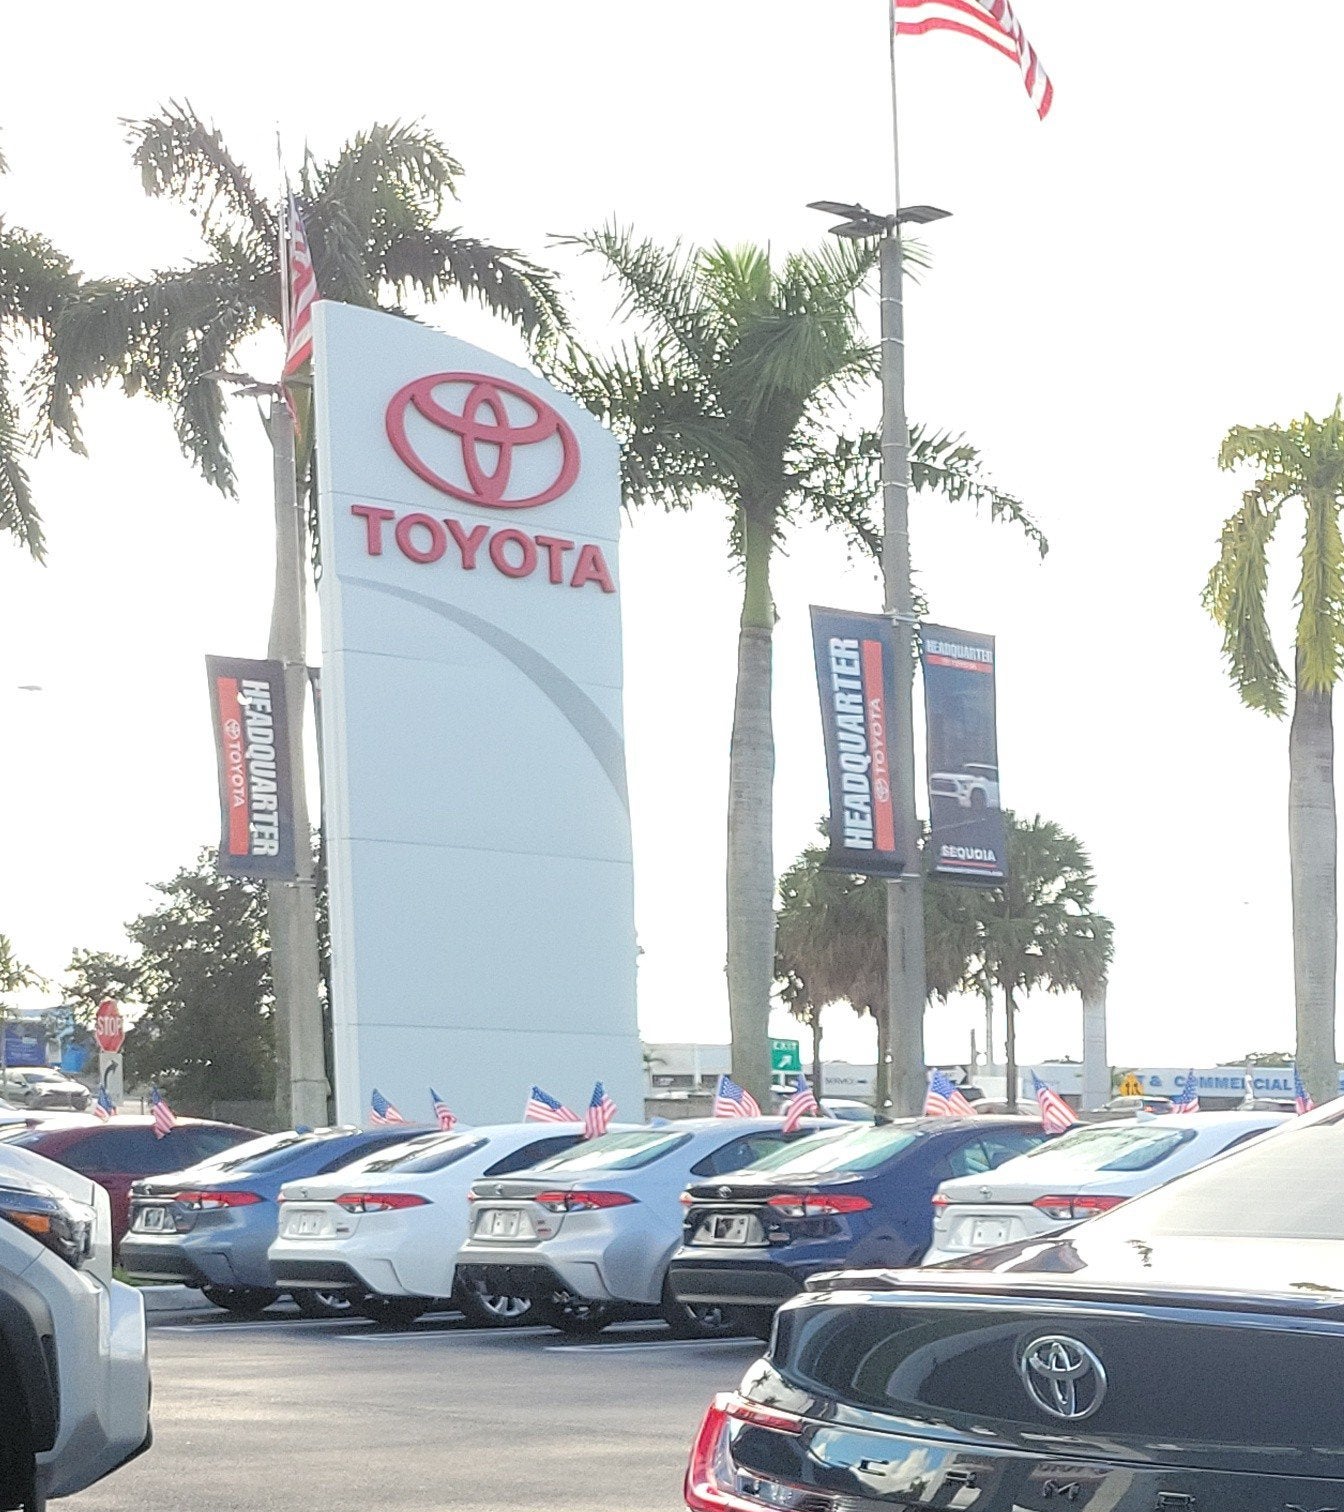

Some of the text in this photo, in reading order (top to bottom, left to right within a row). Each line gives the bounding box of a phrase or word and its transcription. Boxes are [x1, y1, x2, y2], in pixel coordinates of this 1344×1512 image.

[351, 504, 616, 593] TOYOTA
[242, 680, 280, 856] HEADQUARTER
[829, 637, 873, 849] HEADQUARTER
[868, 698, 885, 776] TOYOTA
[227, 742, 246, 808] TOYOTA
[942, 845, 996, 861] SEQUOIA
[97, 1015, 124, 1036] STOP
[1174, 1075, 1293, 1091] CMMECIAL
